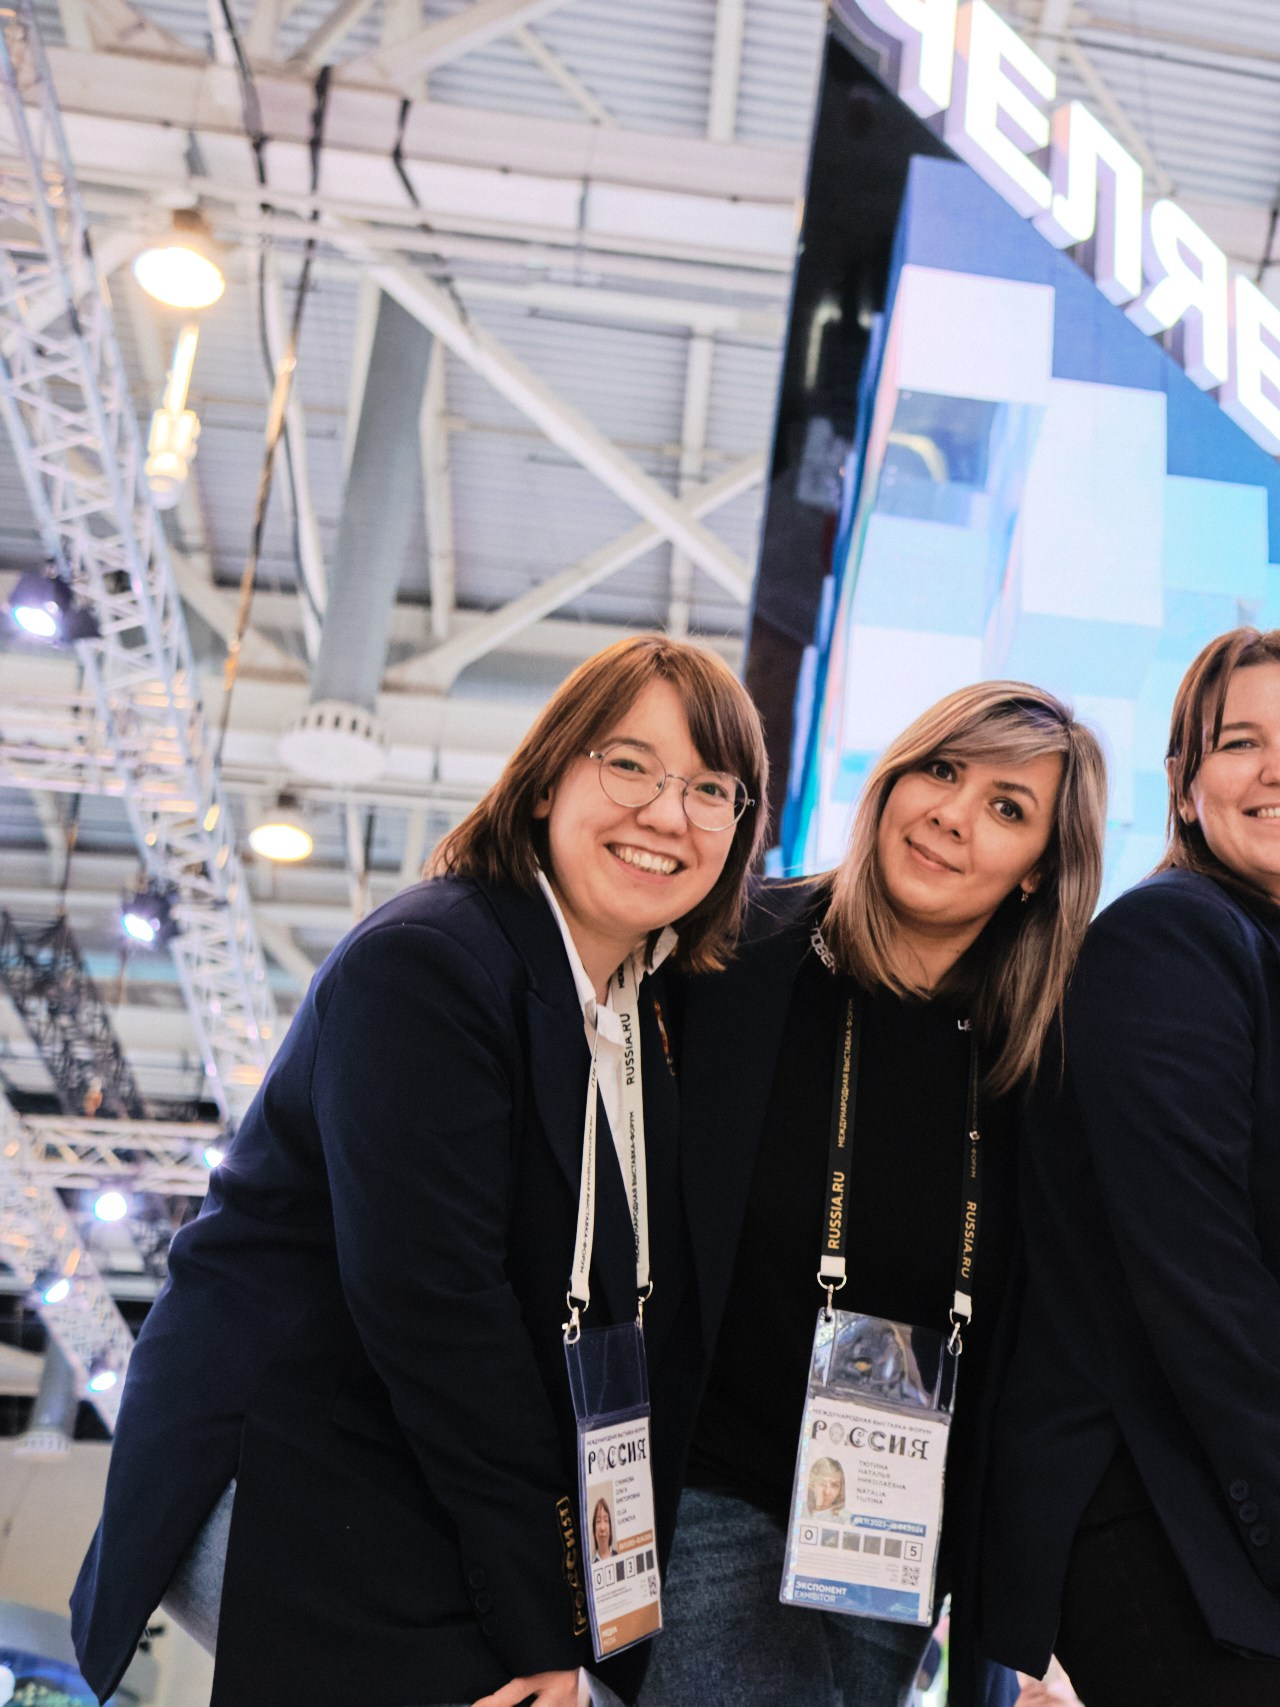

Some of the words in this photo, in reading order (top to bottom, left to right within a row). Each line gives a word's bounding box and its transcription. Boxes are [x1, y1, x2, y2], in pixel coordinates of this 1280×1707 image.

[620, 1013, 636, 1086] RUSSIA.RU
[827, 1170, 846, 1250] RUSSIA.RU
[961, 1200, 977, 1279] RUSSIA.RU
[588, 1438, 646, 1475] РОССИЯ
[811, 1419, 929, 1460] РОССИЯ
[909, 1545, 917, 1557] 5
[795, 1580, 848, 1596] ЭКСПОНЕНТ
